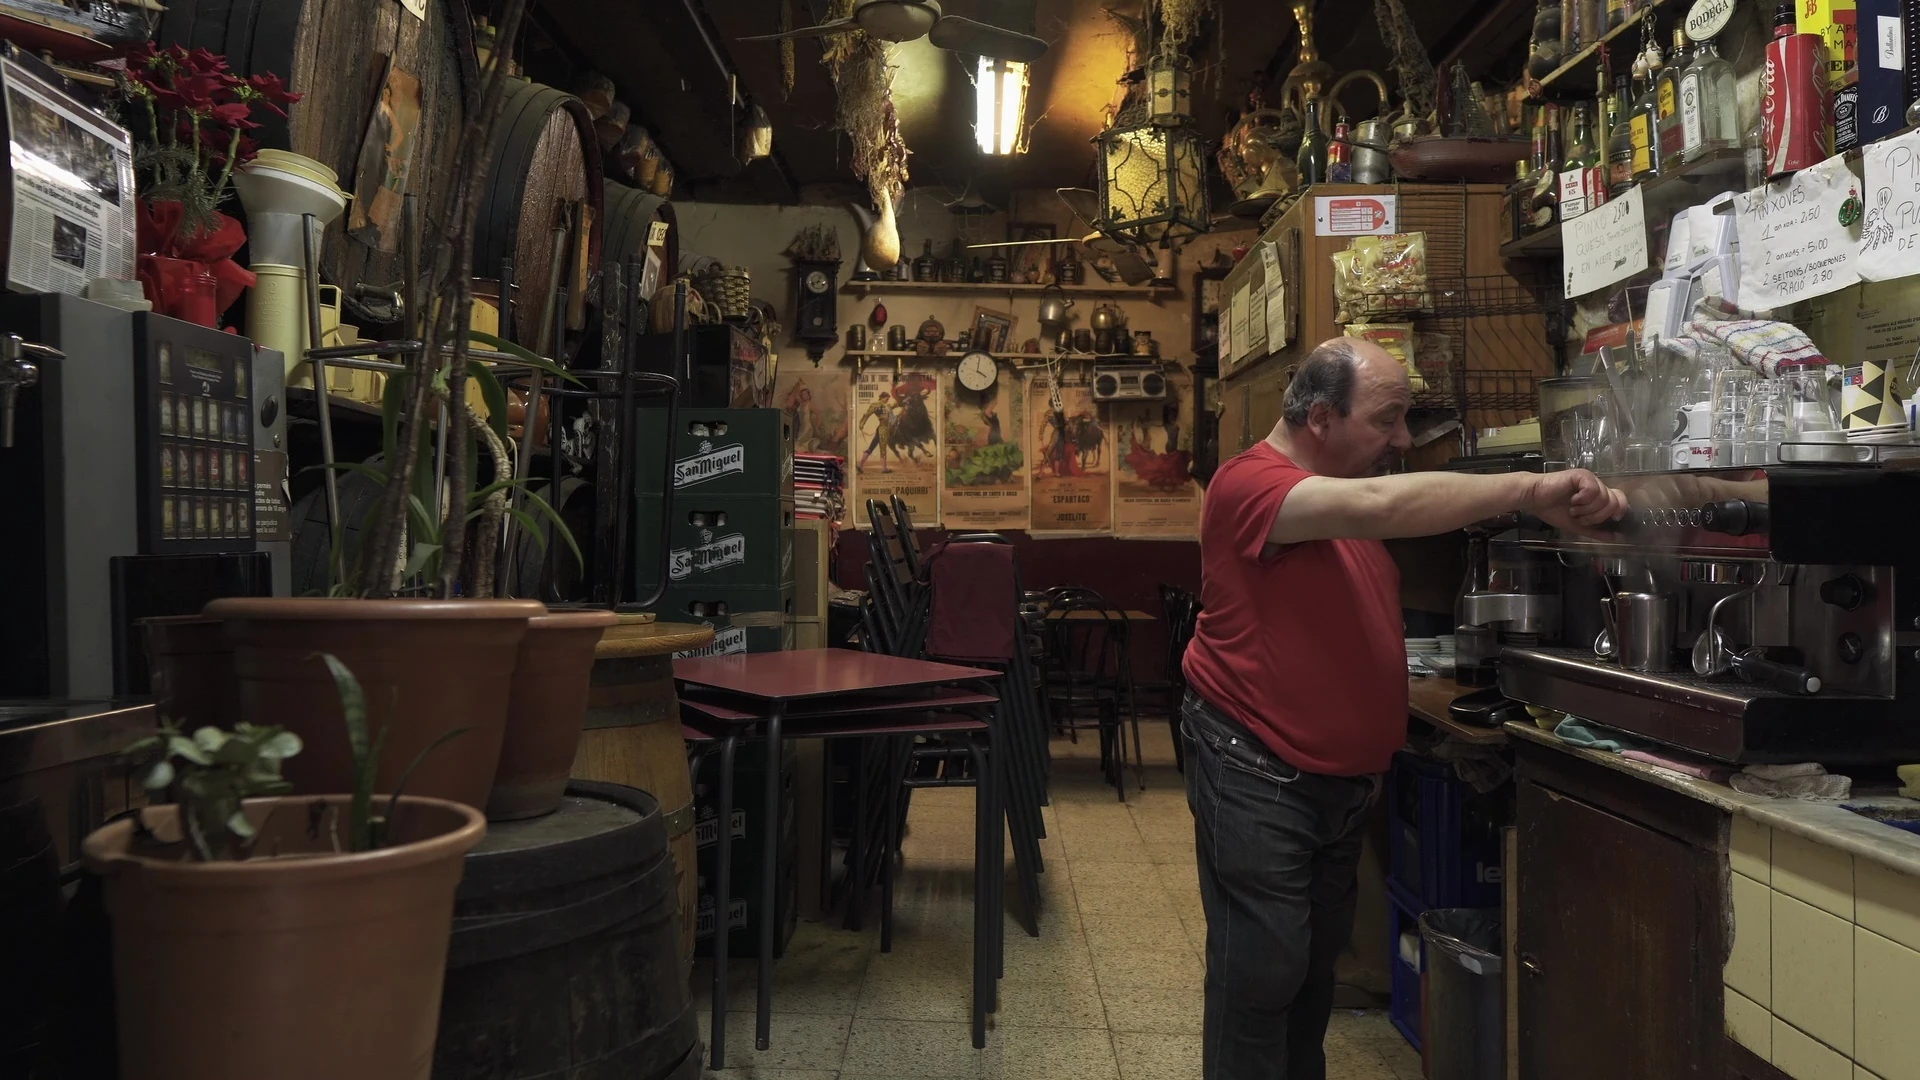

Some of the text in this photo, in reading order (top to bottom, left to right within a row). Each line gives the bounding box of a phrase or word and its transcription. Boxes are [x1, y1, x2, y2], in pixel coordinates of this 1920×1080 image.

[1690, 0, 1729, 31] BODEGA
[1574, 212, 1608, 239] PINXO
[1576, 235, 1605, 257] QUESO
[1898, 233, 1919, 252] DE
[1765, 250, 1772, 265] 2
[1581, 261, 1591, 274] EN
[1763, 273, 1769, 286] 2
